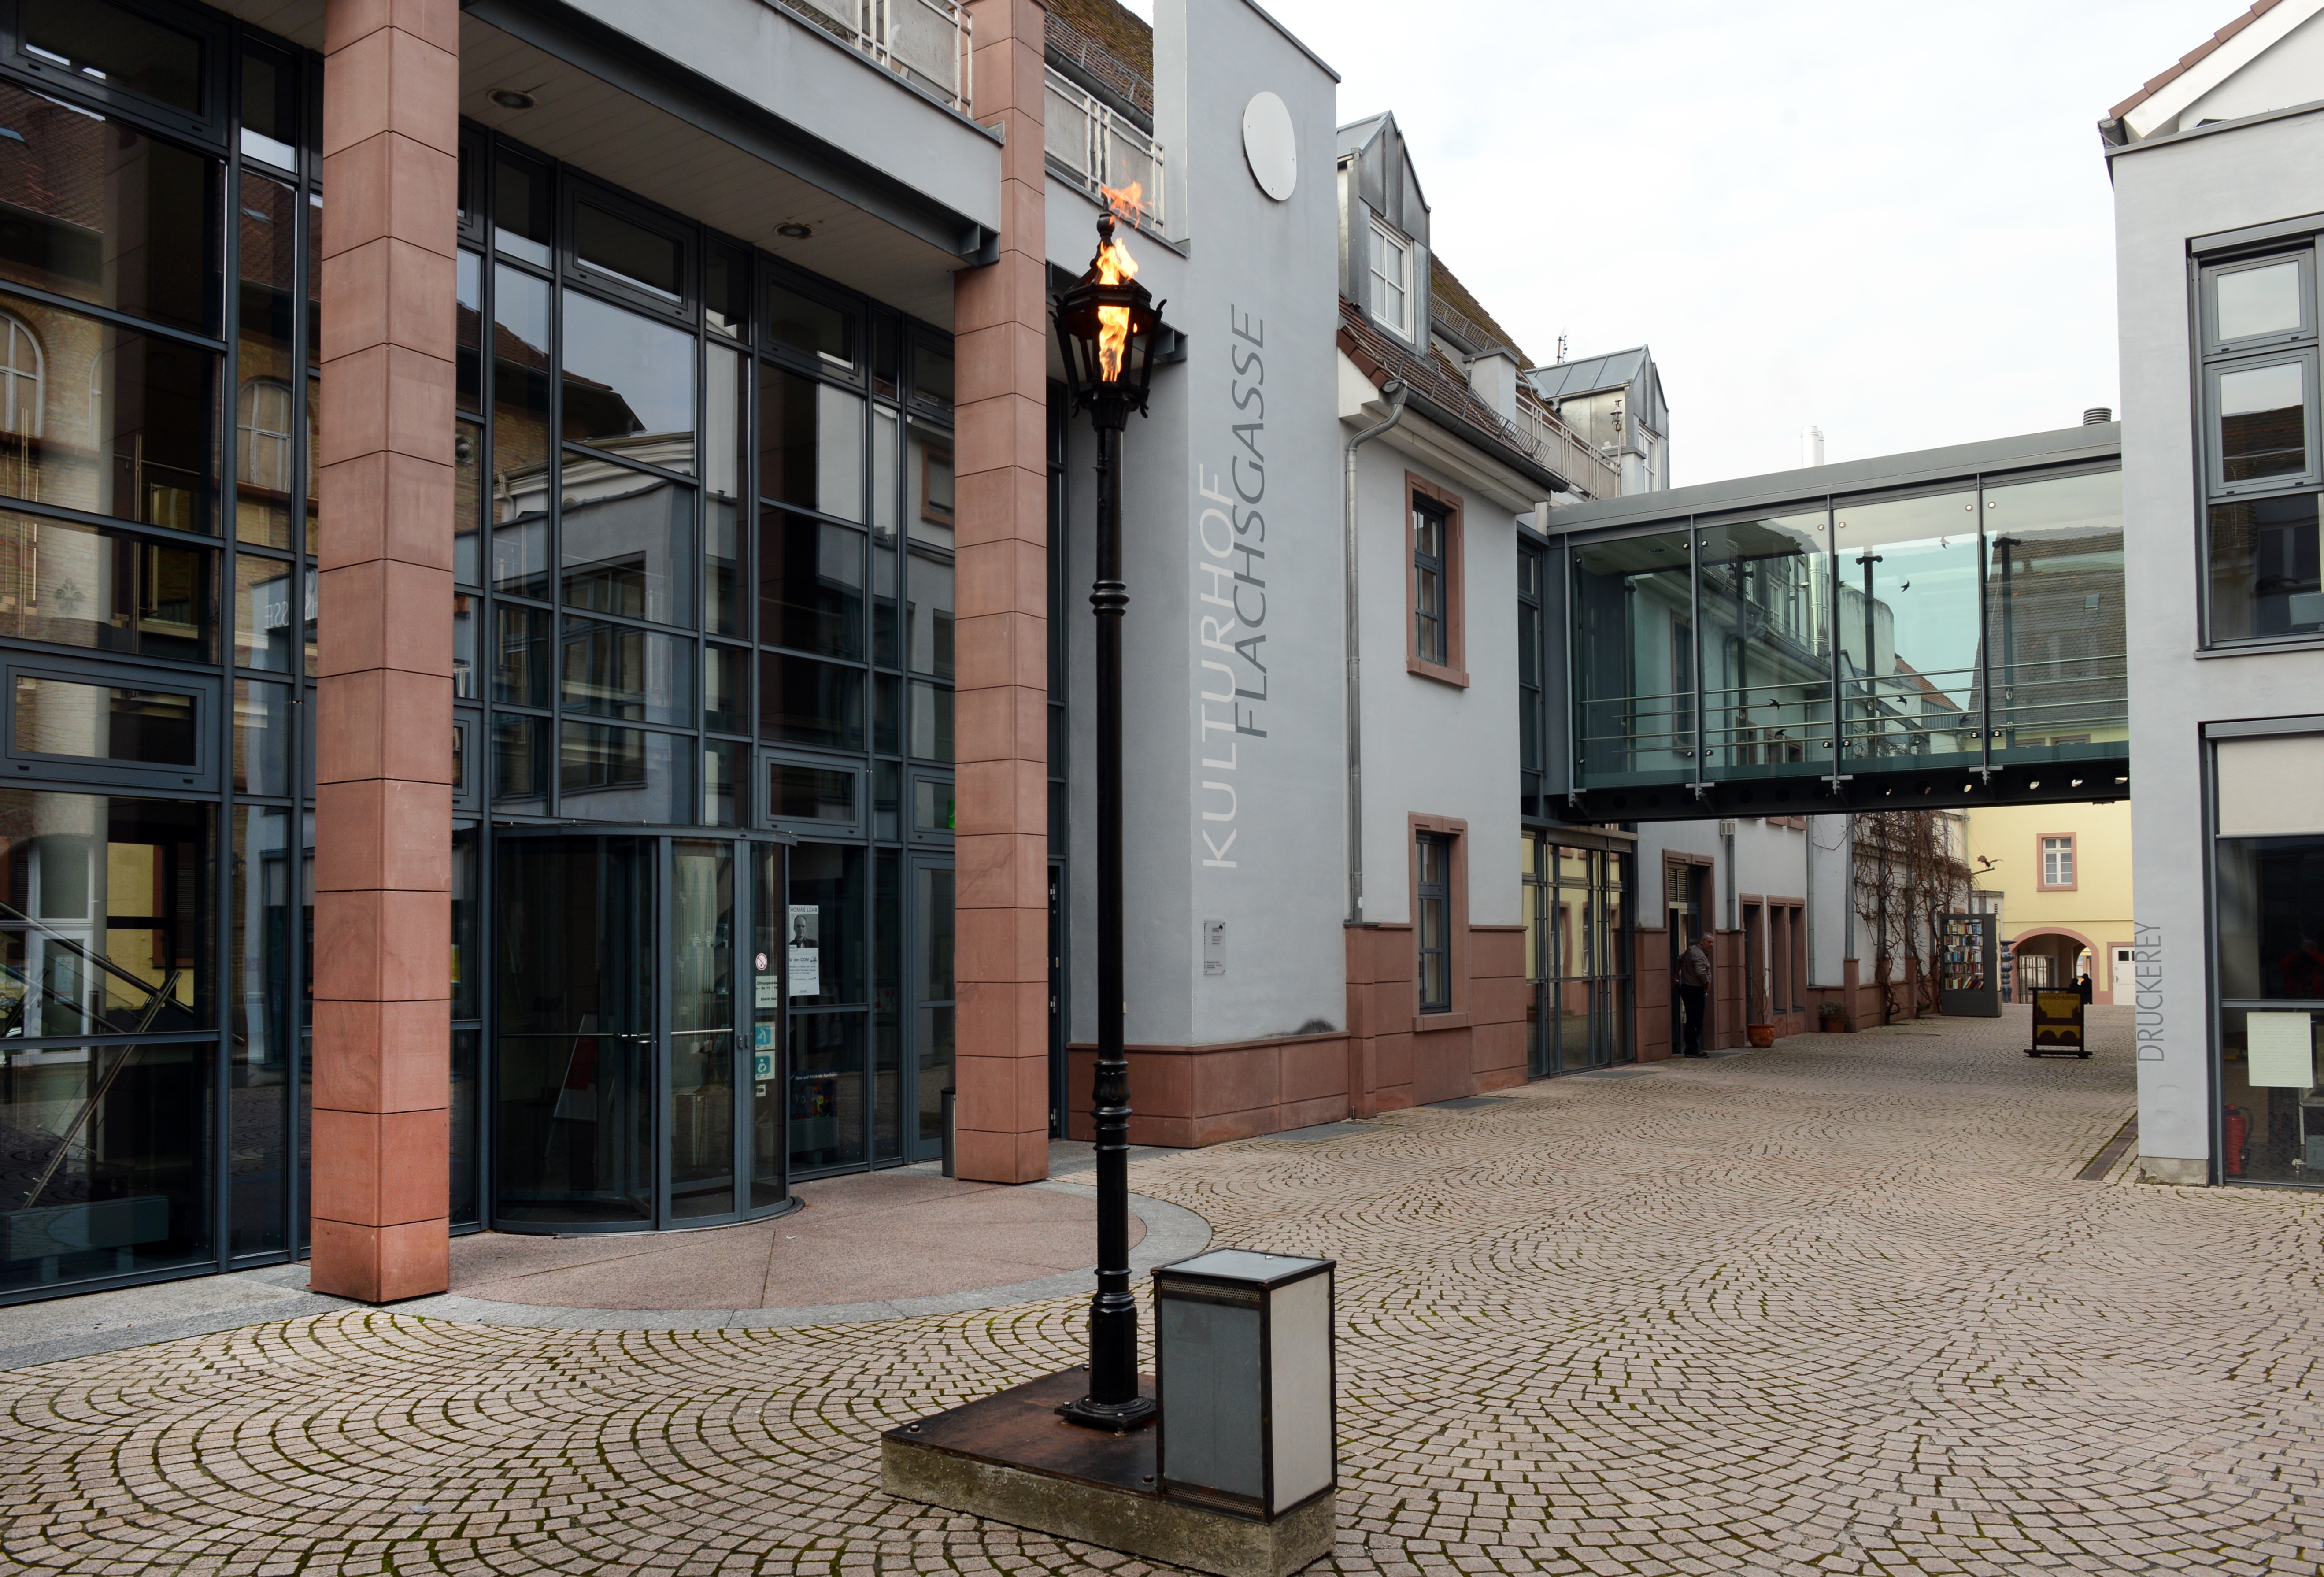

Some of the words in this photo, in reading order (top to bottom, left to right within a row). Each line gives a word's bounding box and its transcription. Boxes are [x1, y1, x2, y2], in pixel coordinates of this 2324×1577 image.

[1199, 463, 1237, 868] KULTURHOF
[1231, 303, 1267, 739] FLACHSGASSE
[2134, 921, 2165, 1062] DRUCKEREY
